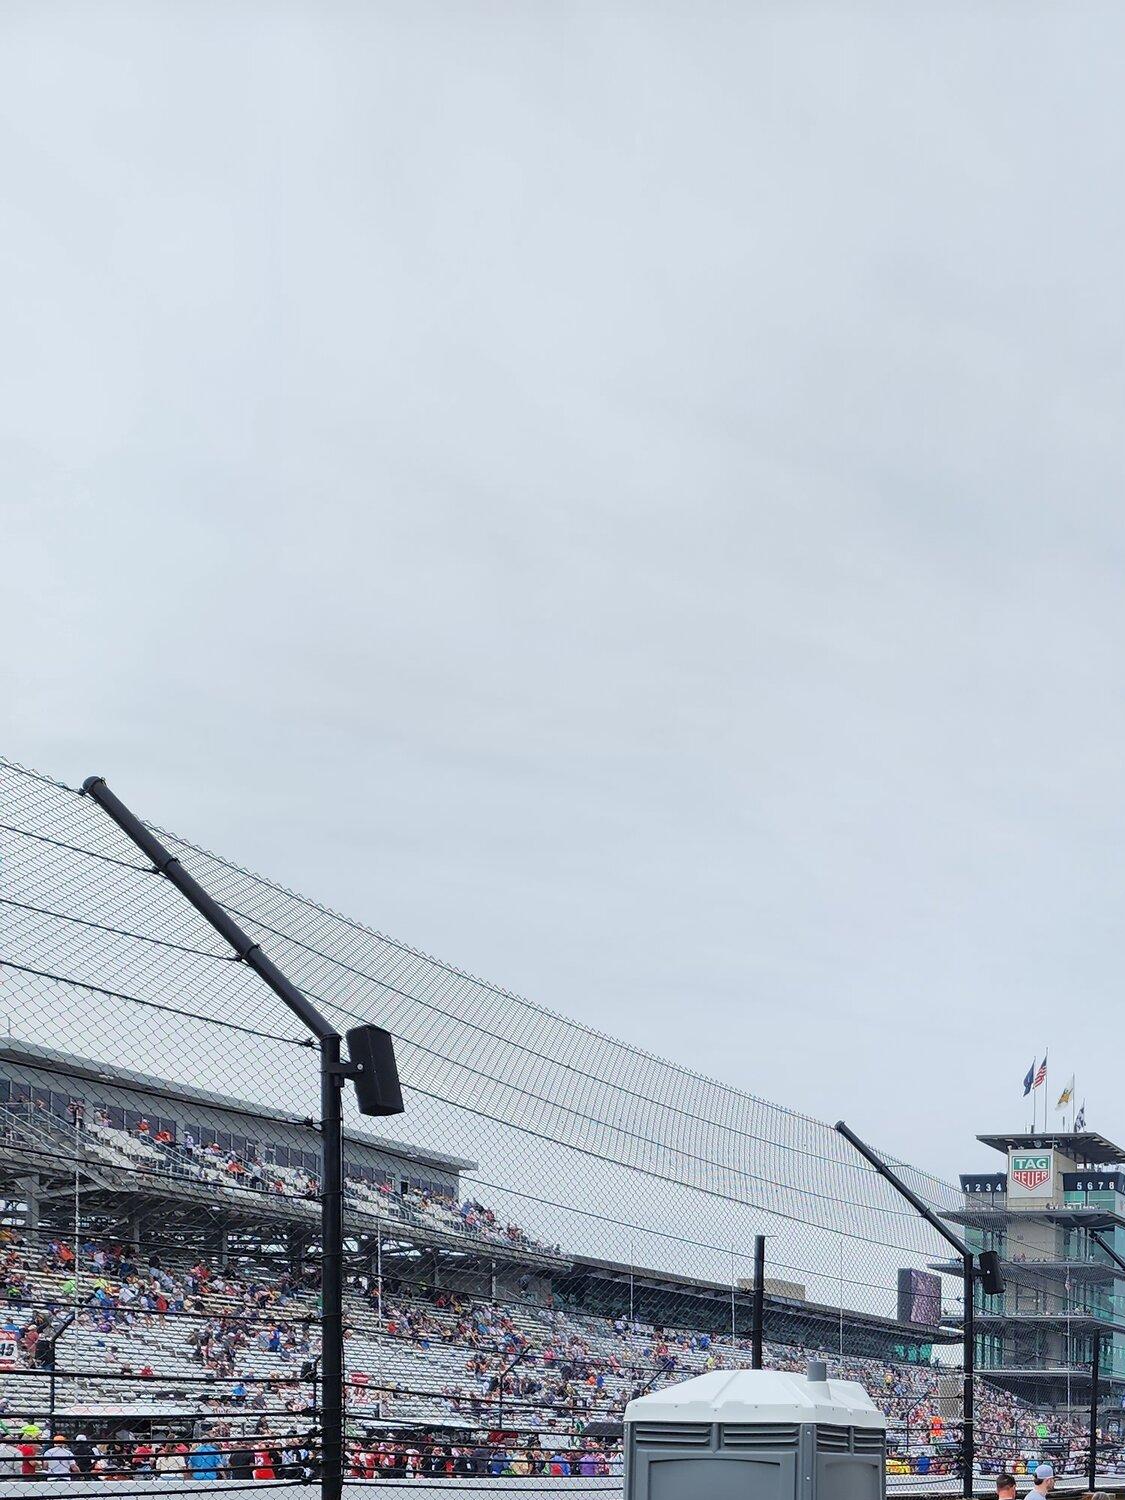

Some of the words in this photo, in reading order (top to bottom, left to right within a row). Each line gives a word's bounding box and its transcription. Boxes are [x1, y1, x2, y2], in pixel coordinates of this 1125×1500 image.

[1015, 1159, 1047, 1169] TAG
[1014, 1171, 1048, 1187] HEUER
[985, 1183, 991, 1191] 3
[996, 1183, 1002, 1191] 4
[1076, 1182, 1082, 1190] 5
[1087, 1182, 1093, 1190] 6
[1098, 1182, 1104, 1190] 7
[1109, 1182, 1115, 1190] 8
